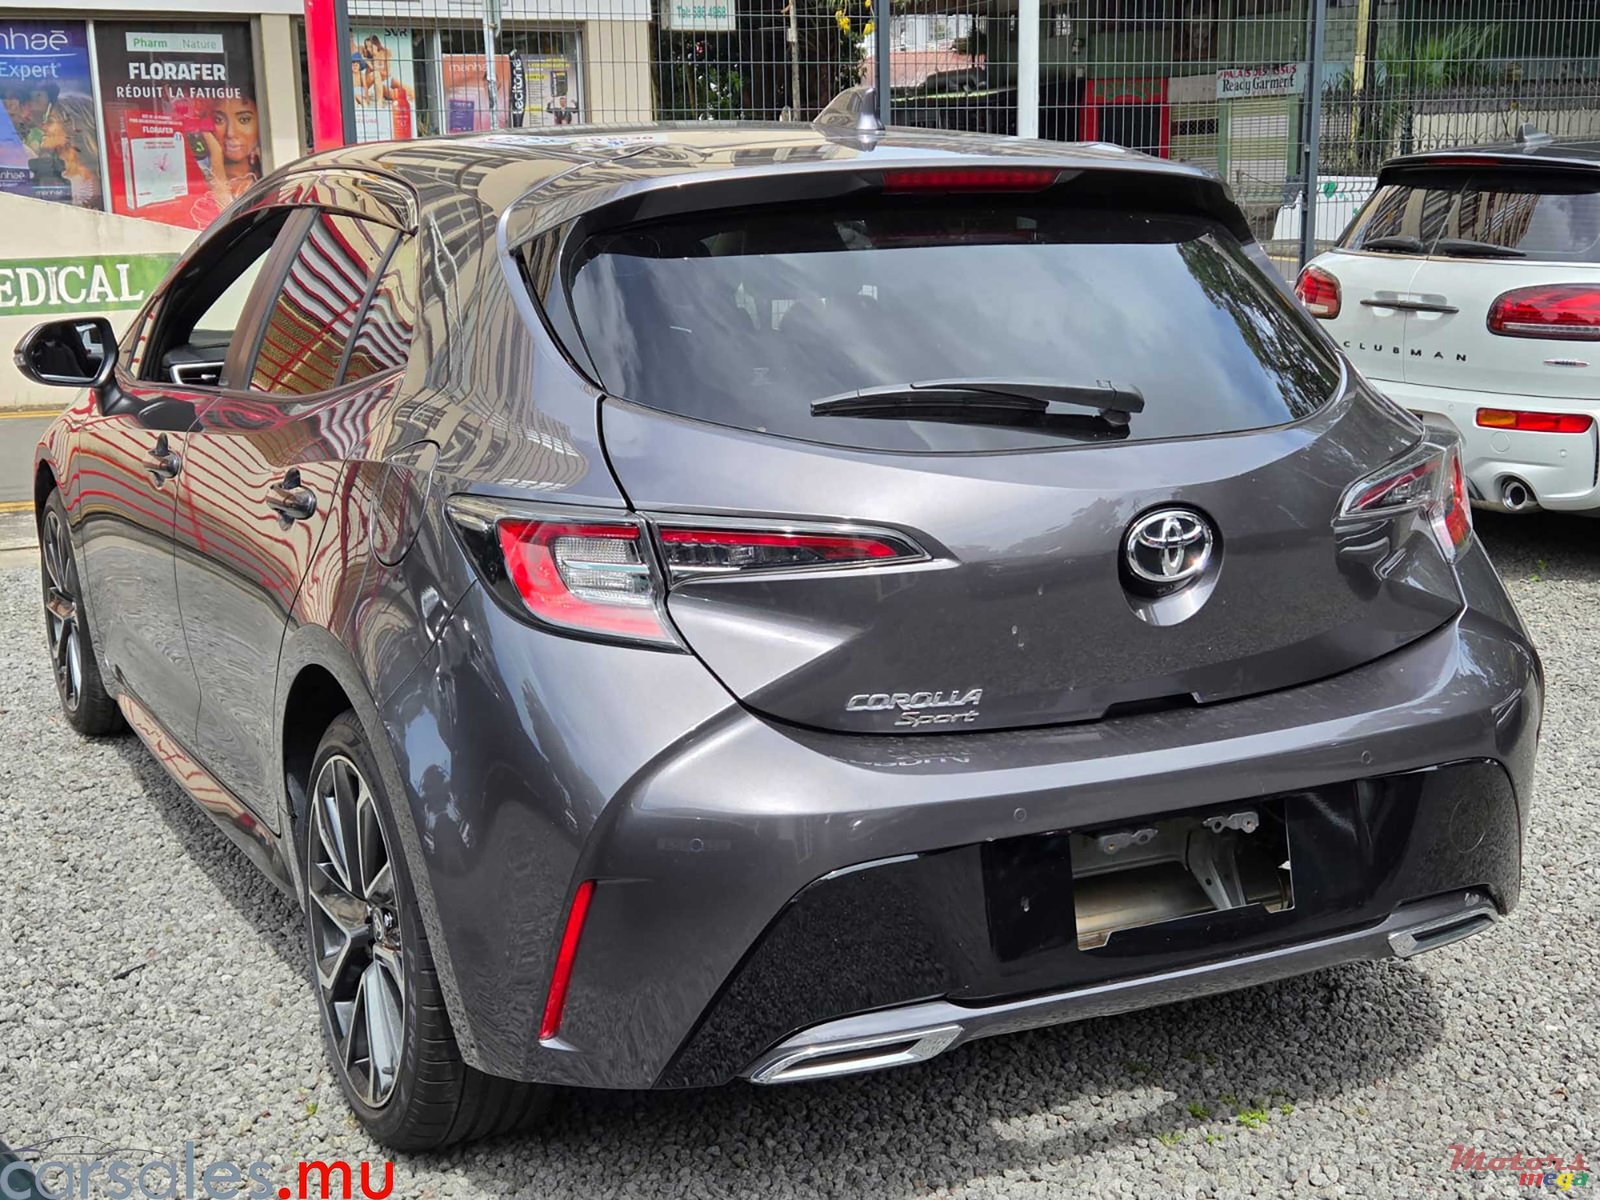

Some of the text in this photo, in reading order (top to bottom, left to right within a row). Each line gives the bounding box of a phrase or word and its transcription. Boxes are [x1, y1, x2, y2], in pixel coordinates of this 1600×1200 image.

[133, 37, 218, 50] Pharm Nature
[128, 62, 227, 81] FLORAFER
[116, 83, 242, 100] RÉDUIT LA FATIGUE
[1222, 79, 1251, 95] Ready
[1252, 75, 1294, 90] Garment
[0, 263, 145, 308] EDICAL
[1343, 340, 1467, 362] CLUBMAN
[846, 688, 984, 712] COROLLA
[894, 710, 980, 728] Sport
